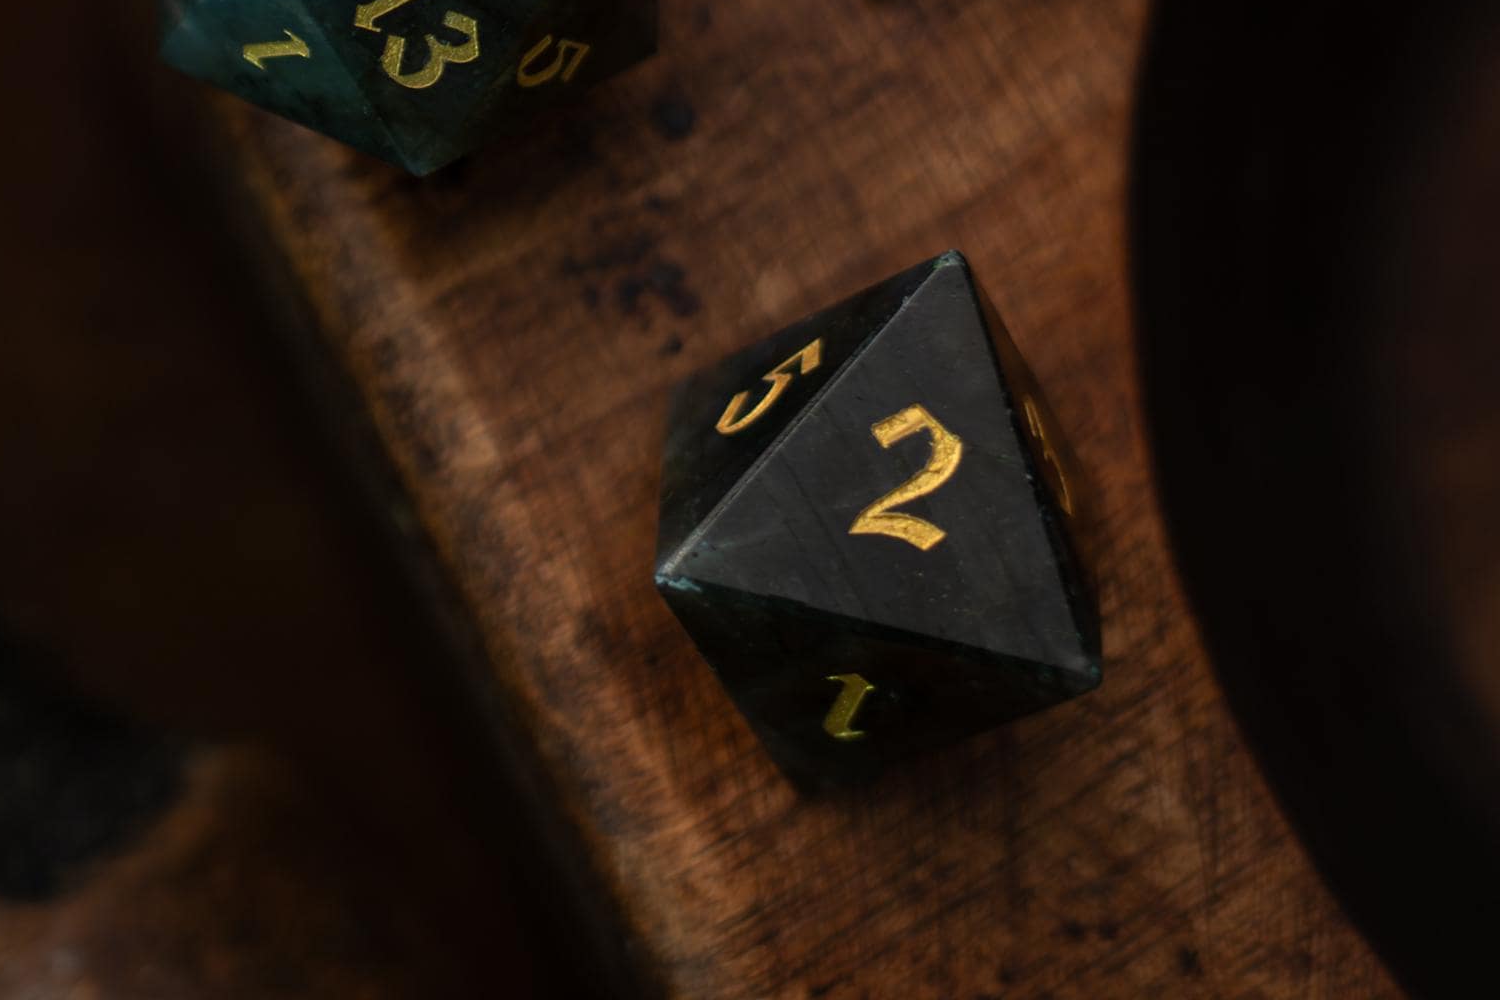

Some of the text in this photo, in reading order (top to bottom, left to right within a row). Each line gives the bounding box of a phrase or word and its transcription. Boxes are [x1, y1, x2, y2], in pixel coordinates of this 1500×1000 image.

[515, 33, 592, 88] 5
[714, 336, 826, 437] 5
[847, 402, 965, 553] 2
[820, 671, 876, 742] 1
